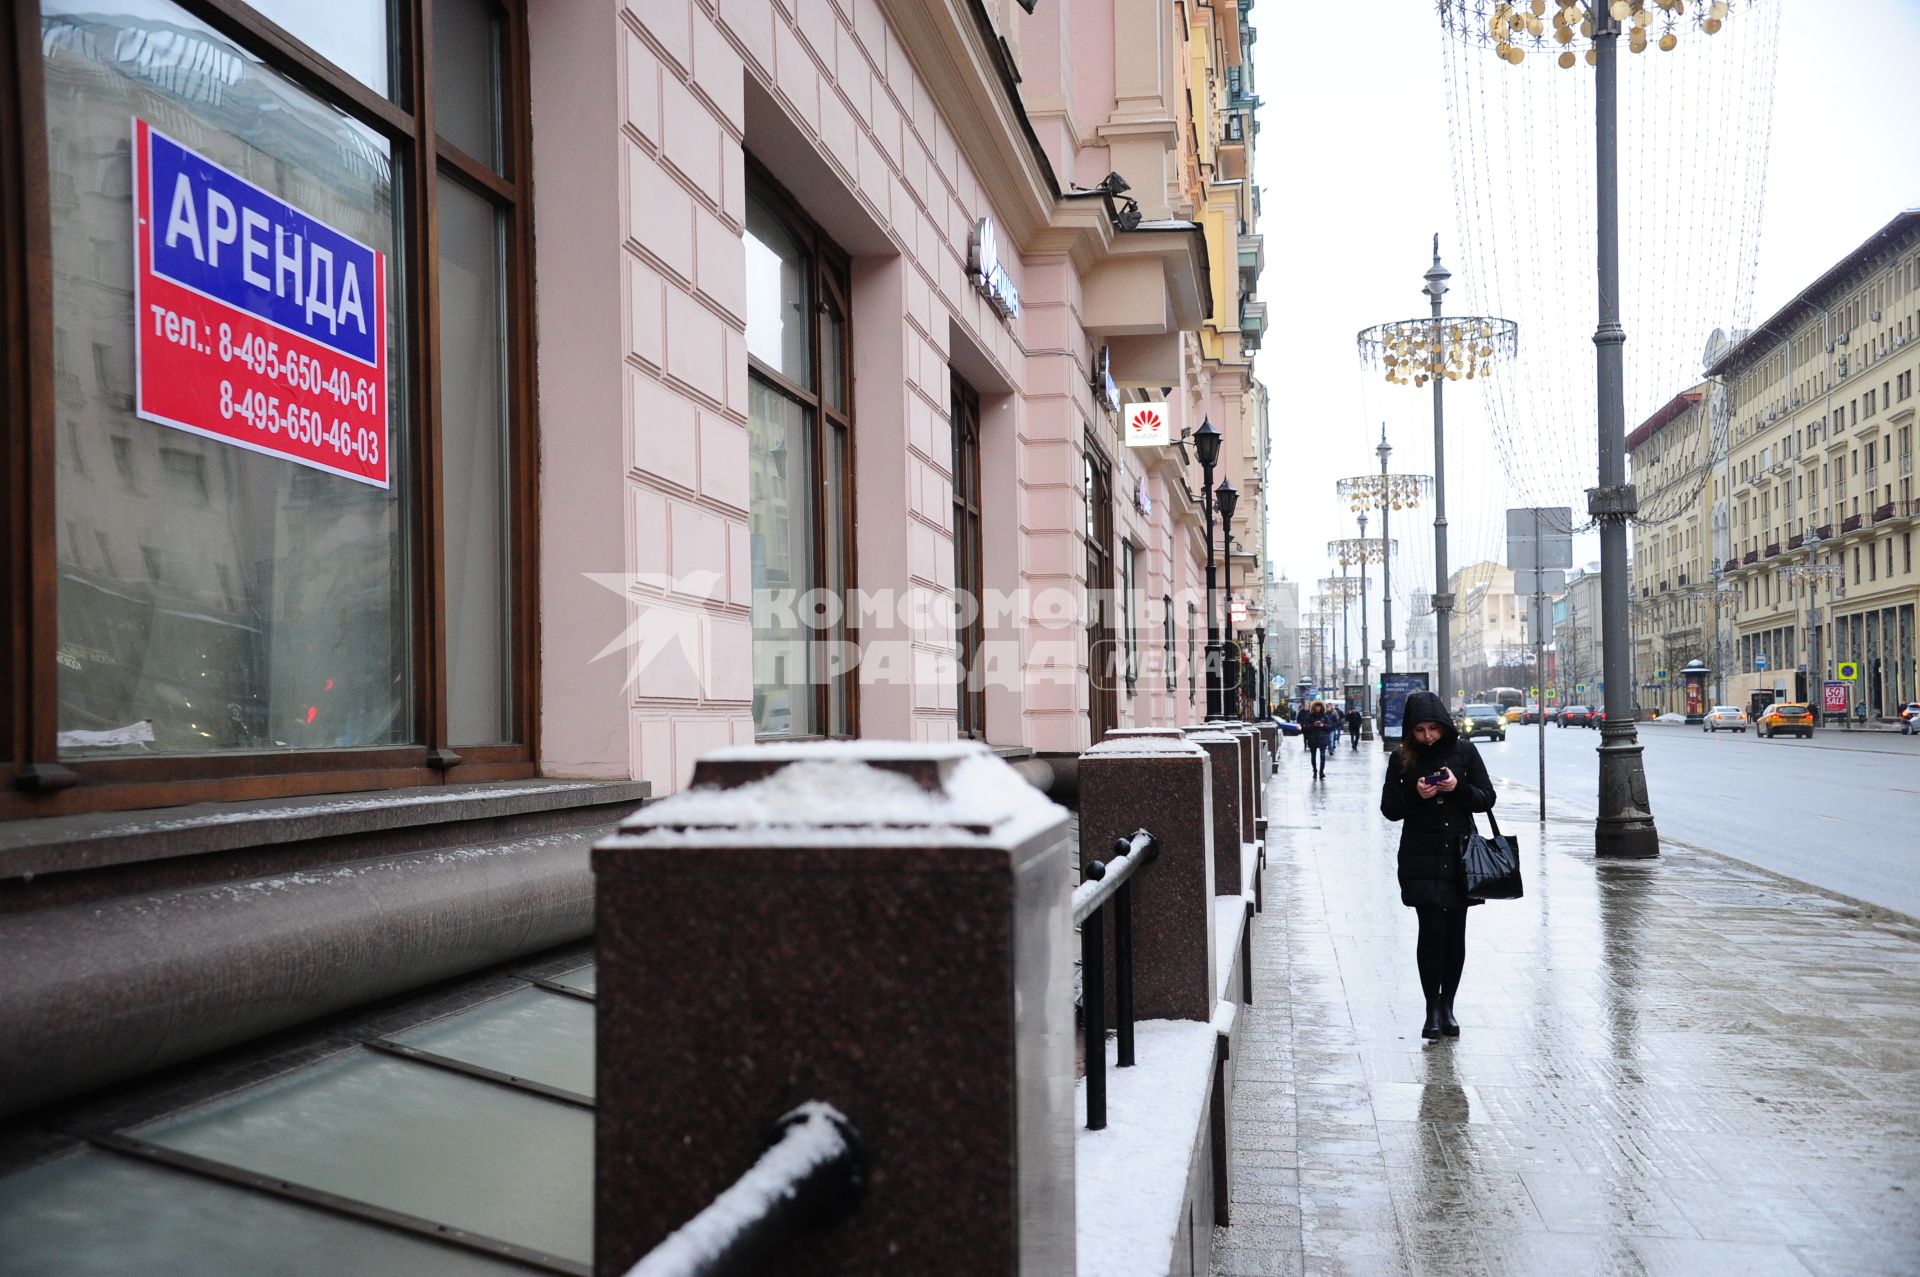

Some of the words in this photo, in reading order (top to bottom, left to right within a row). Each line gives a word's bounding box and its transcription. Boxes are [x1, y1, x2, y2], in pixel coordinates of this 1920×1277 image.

[164, 172, 367, 336] АРЕНДА
[150, 304, 212, 355] тел.:
[218, 322, 377, 416] 8-495-650-40-61
[219, 379, 379, 465] 8-495-650-46-03
[1826, 697, 1845, 705] SALE
